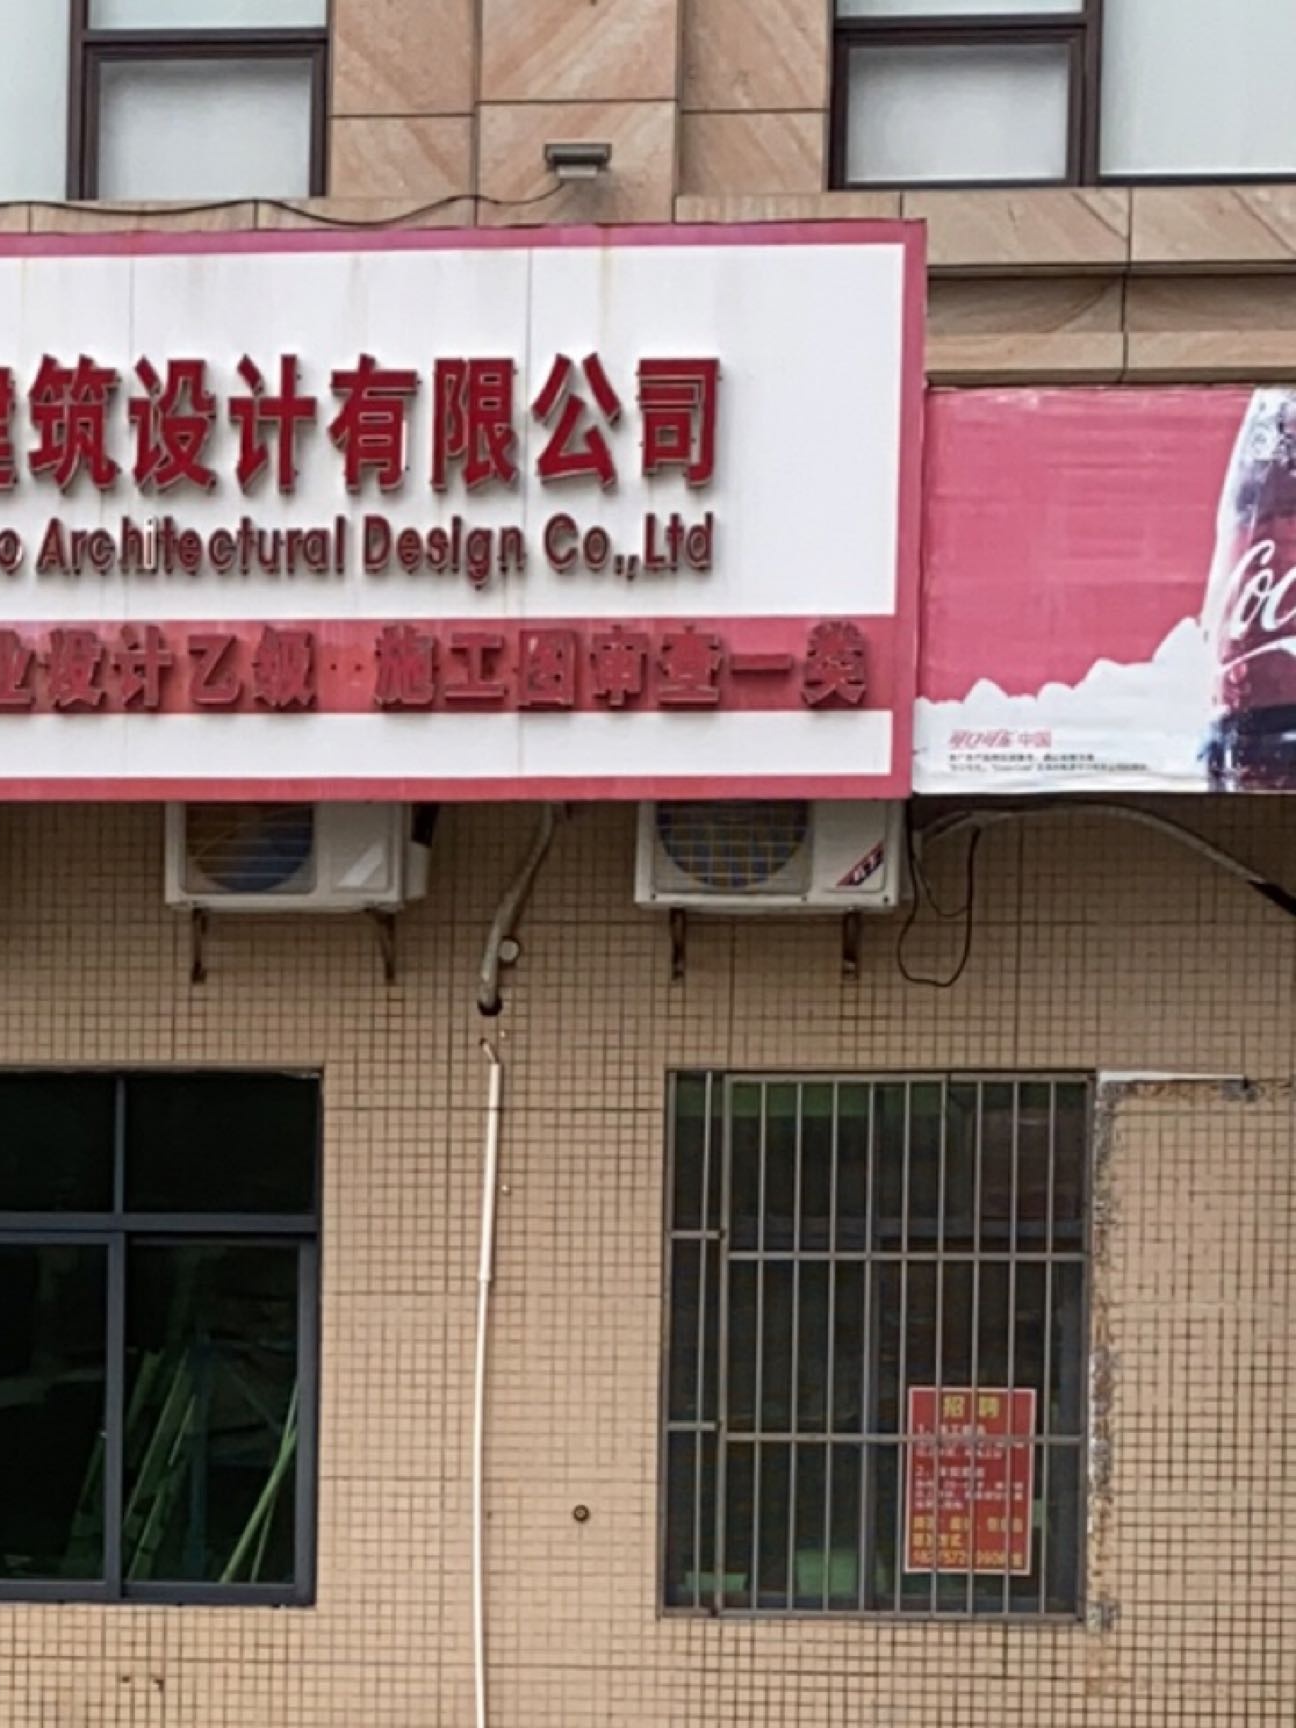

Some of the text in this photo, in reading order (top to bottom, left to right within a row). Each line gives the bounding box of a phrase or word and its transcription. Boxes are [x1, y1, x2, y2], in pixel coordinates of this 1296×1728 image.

[37, 515, 347, 576] Architectural
[362, 514, 525, 590] Design
[541, 512, 715, 580] Co.,Ltd
[374, 621, 868, 708] 施工图审查一类
